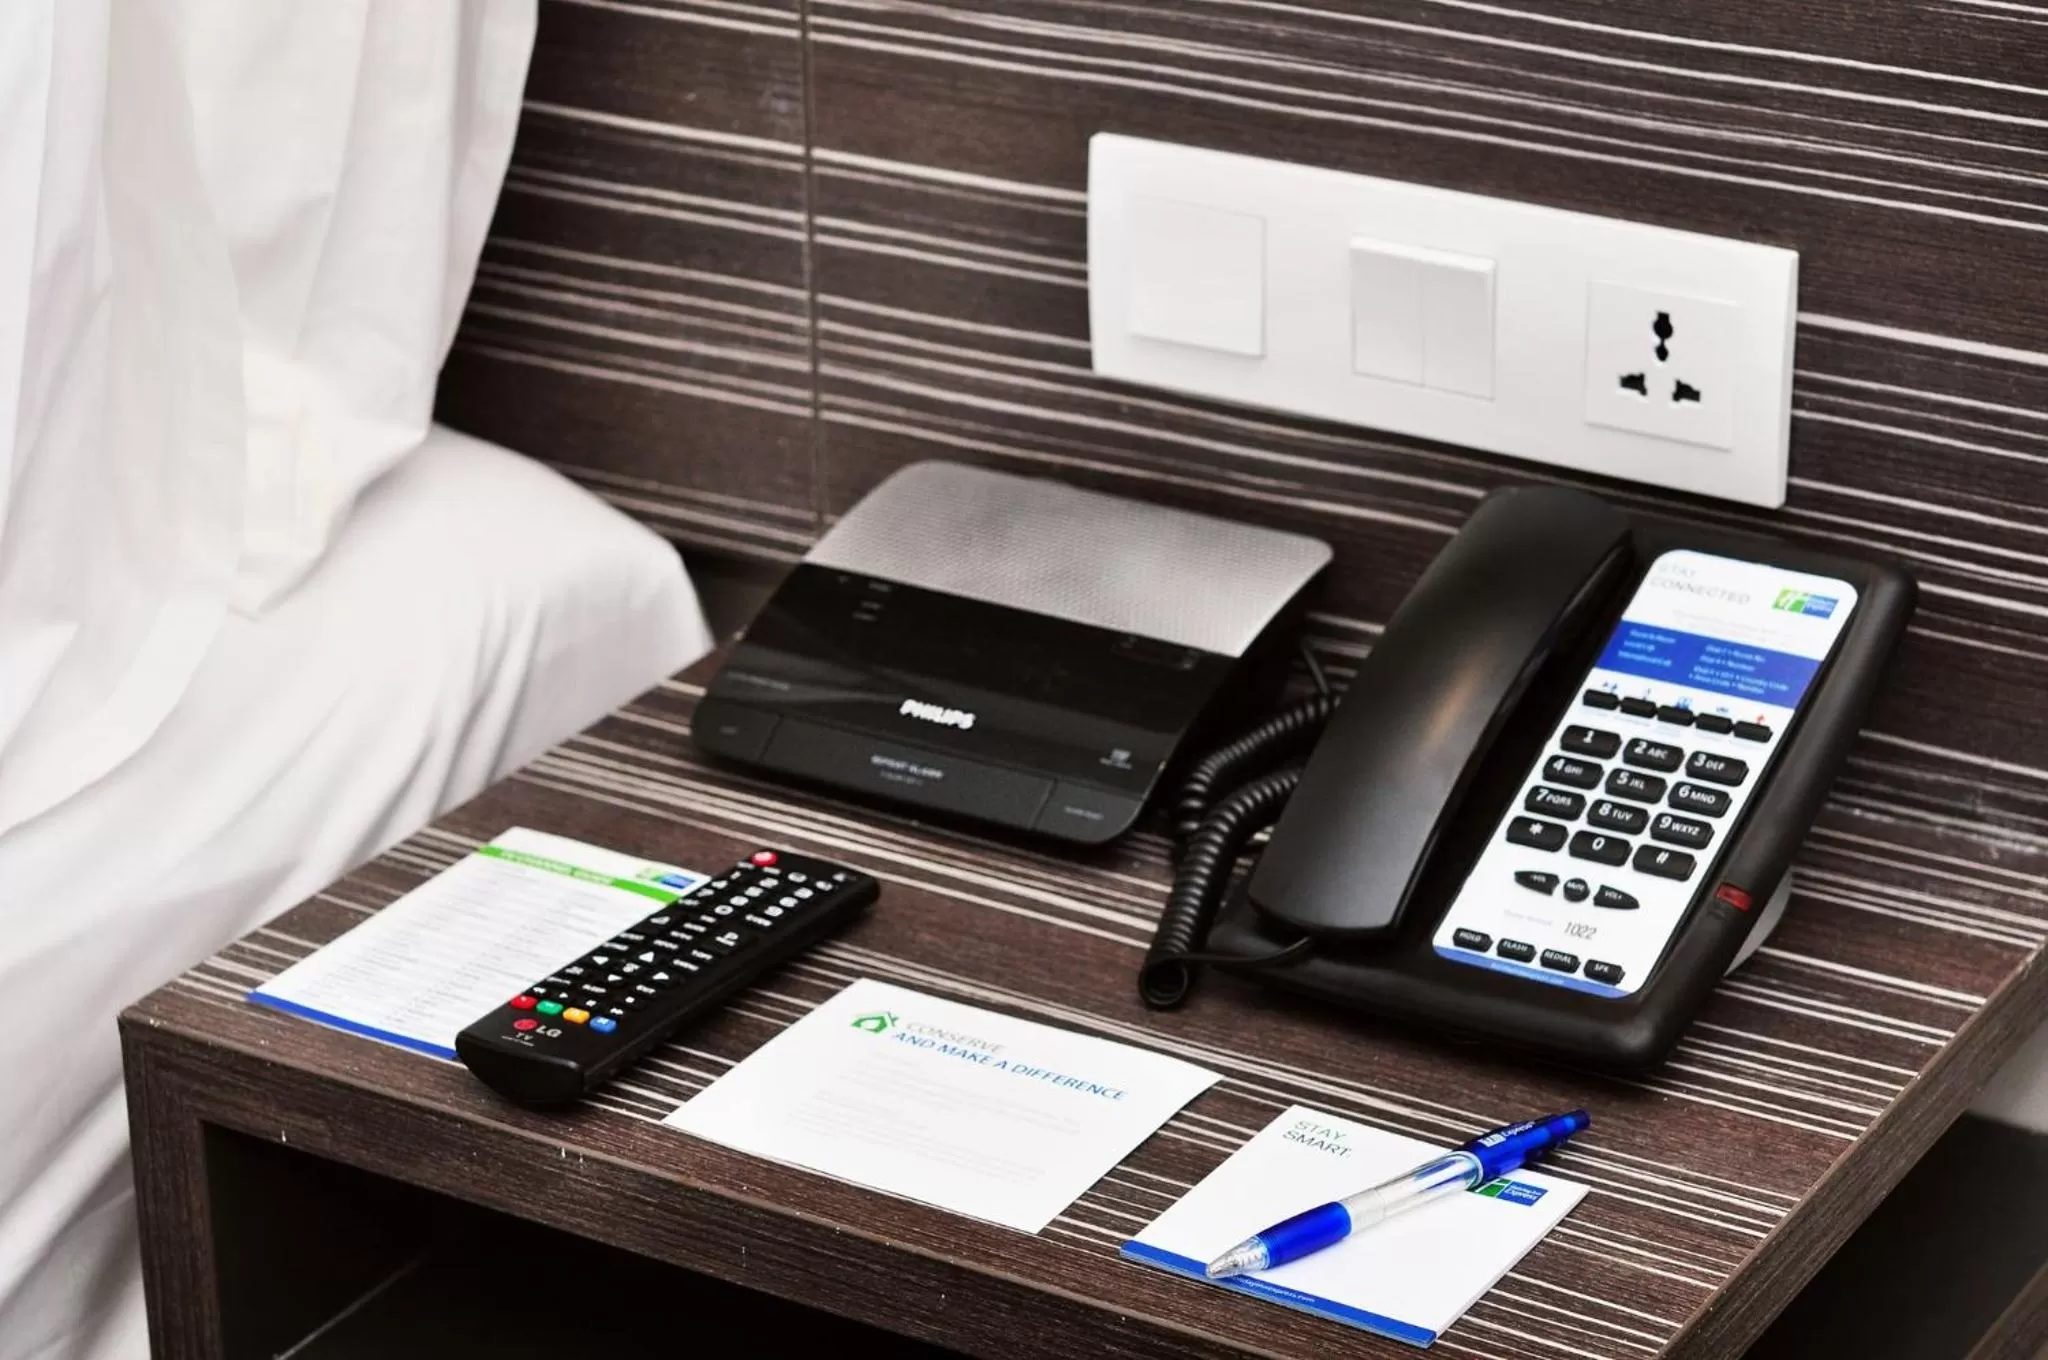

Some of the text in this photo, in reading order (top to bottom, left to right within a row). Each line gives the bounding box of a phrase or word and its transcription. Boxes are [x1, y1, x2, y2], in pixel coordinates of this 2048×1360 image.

[1650, 577, 1752, 605] CONNECTED
[899, 699, 976, 730] PHILIPS
[1582, 730, 1595, 744] 1
[1633, 742, 1669, 760] 2 ABC
[1552, 758, 1564, 772] 4
[1694, 753, 1726, 772] 3 DEF
[1616, 771, 1630, 785] 5
[1536, 788, 1549, 802] 7
[1678, 784, 1716, 805] 6 MNO
[1598, 802, 1634, 821] 8 TUV
[1659, 815, 1700, 836] 9 WXYZ
[1592, 837, 1606, 851] 0
[1564, 921, 1598, 940] 1022
[1543, 951, 1572, 964] REDIAL
[535, 1025, 562, 1038] LG
[906, 1021, 1007, 1053] CONSERVE
[892, 1031, 1129, 1101] AND MAKE A DIFFERENCE
[1294, 1120, 1348, 1140] STAY
[1282, 1129, 1353, 1156] SMART
